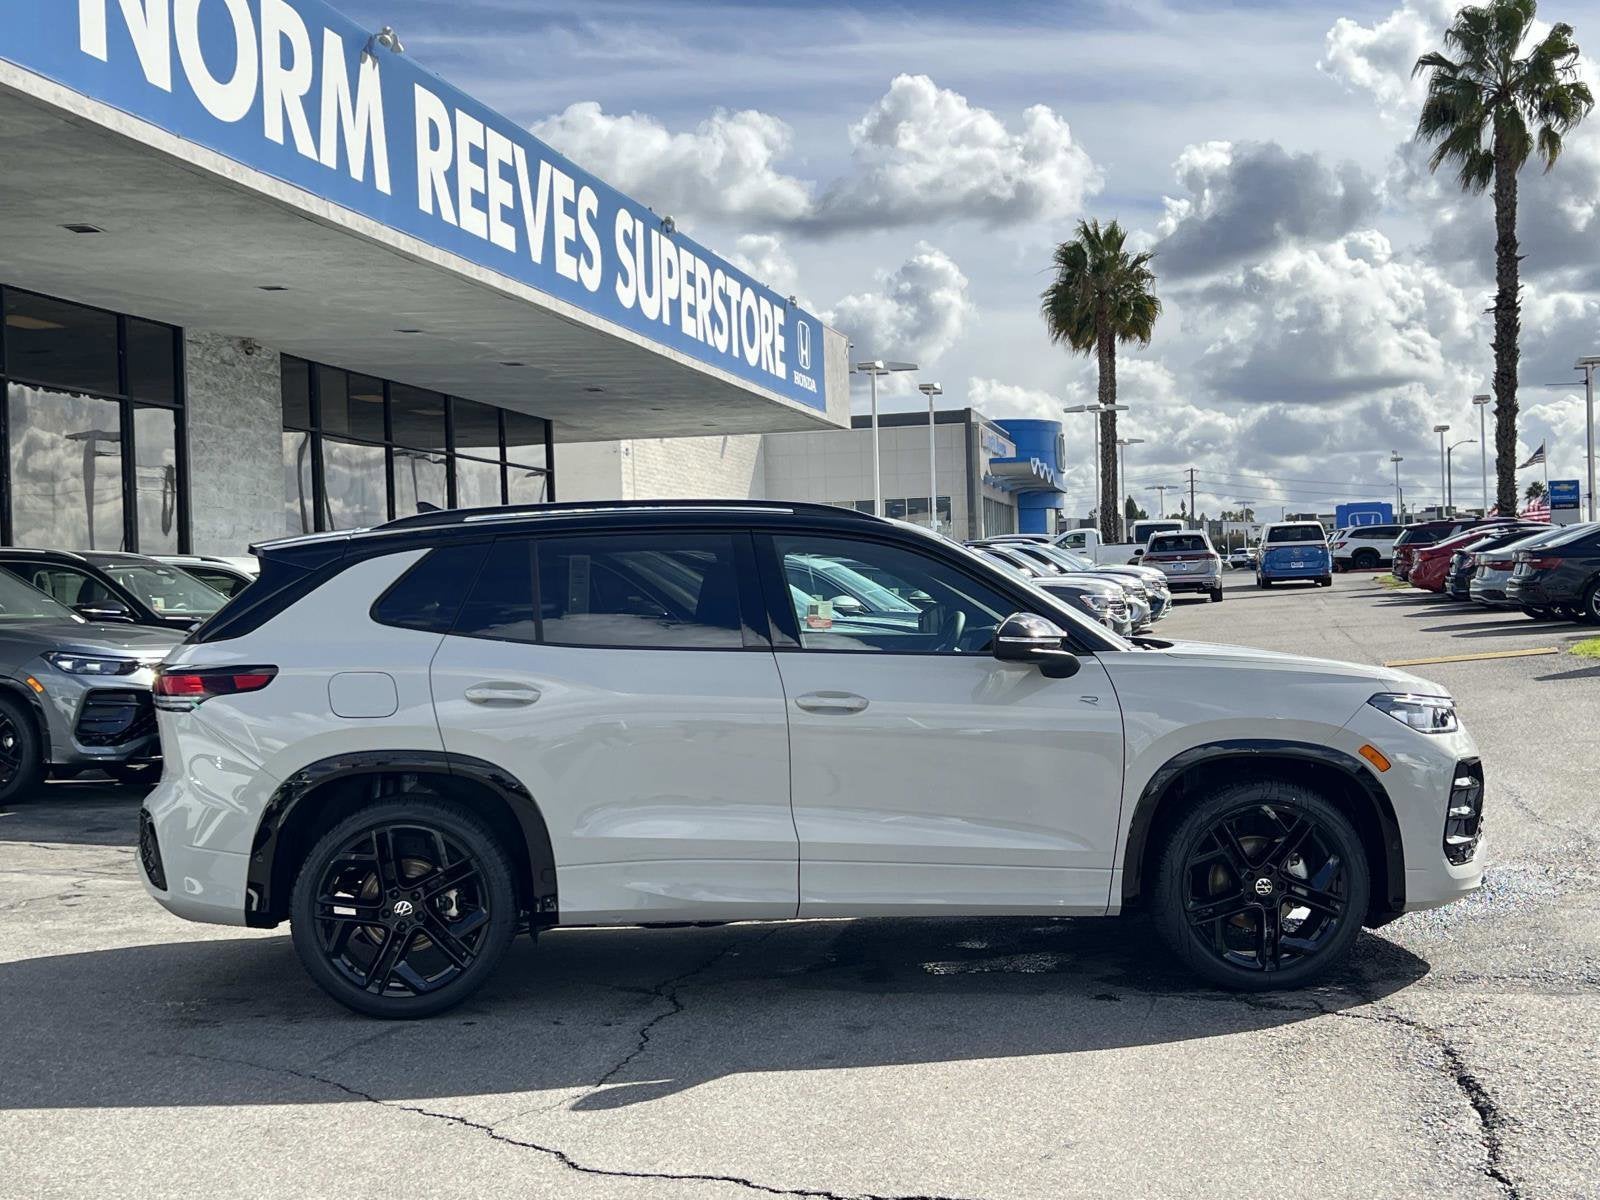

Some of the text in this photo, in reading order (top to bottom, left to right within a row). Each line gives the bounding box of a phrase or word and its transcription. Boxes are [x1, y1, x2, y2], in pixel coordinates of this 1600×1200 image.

[414, 83, 602, 293] REEVES
[614, 207, 787, 380] SUPERSTORE
[793, 370, 817, 393] HONDA
